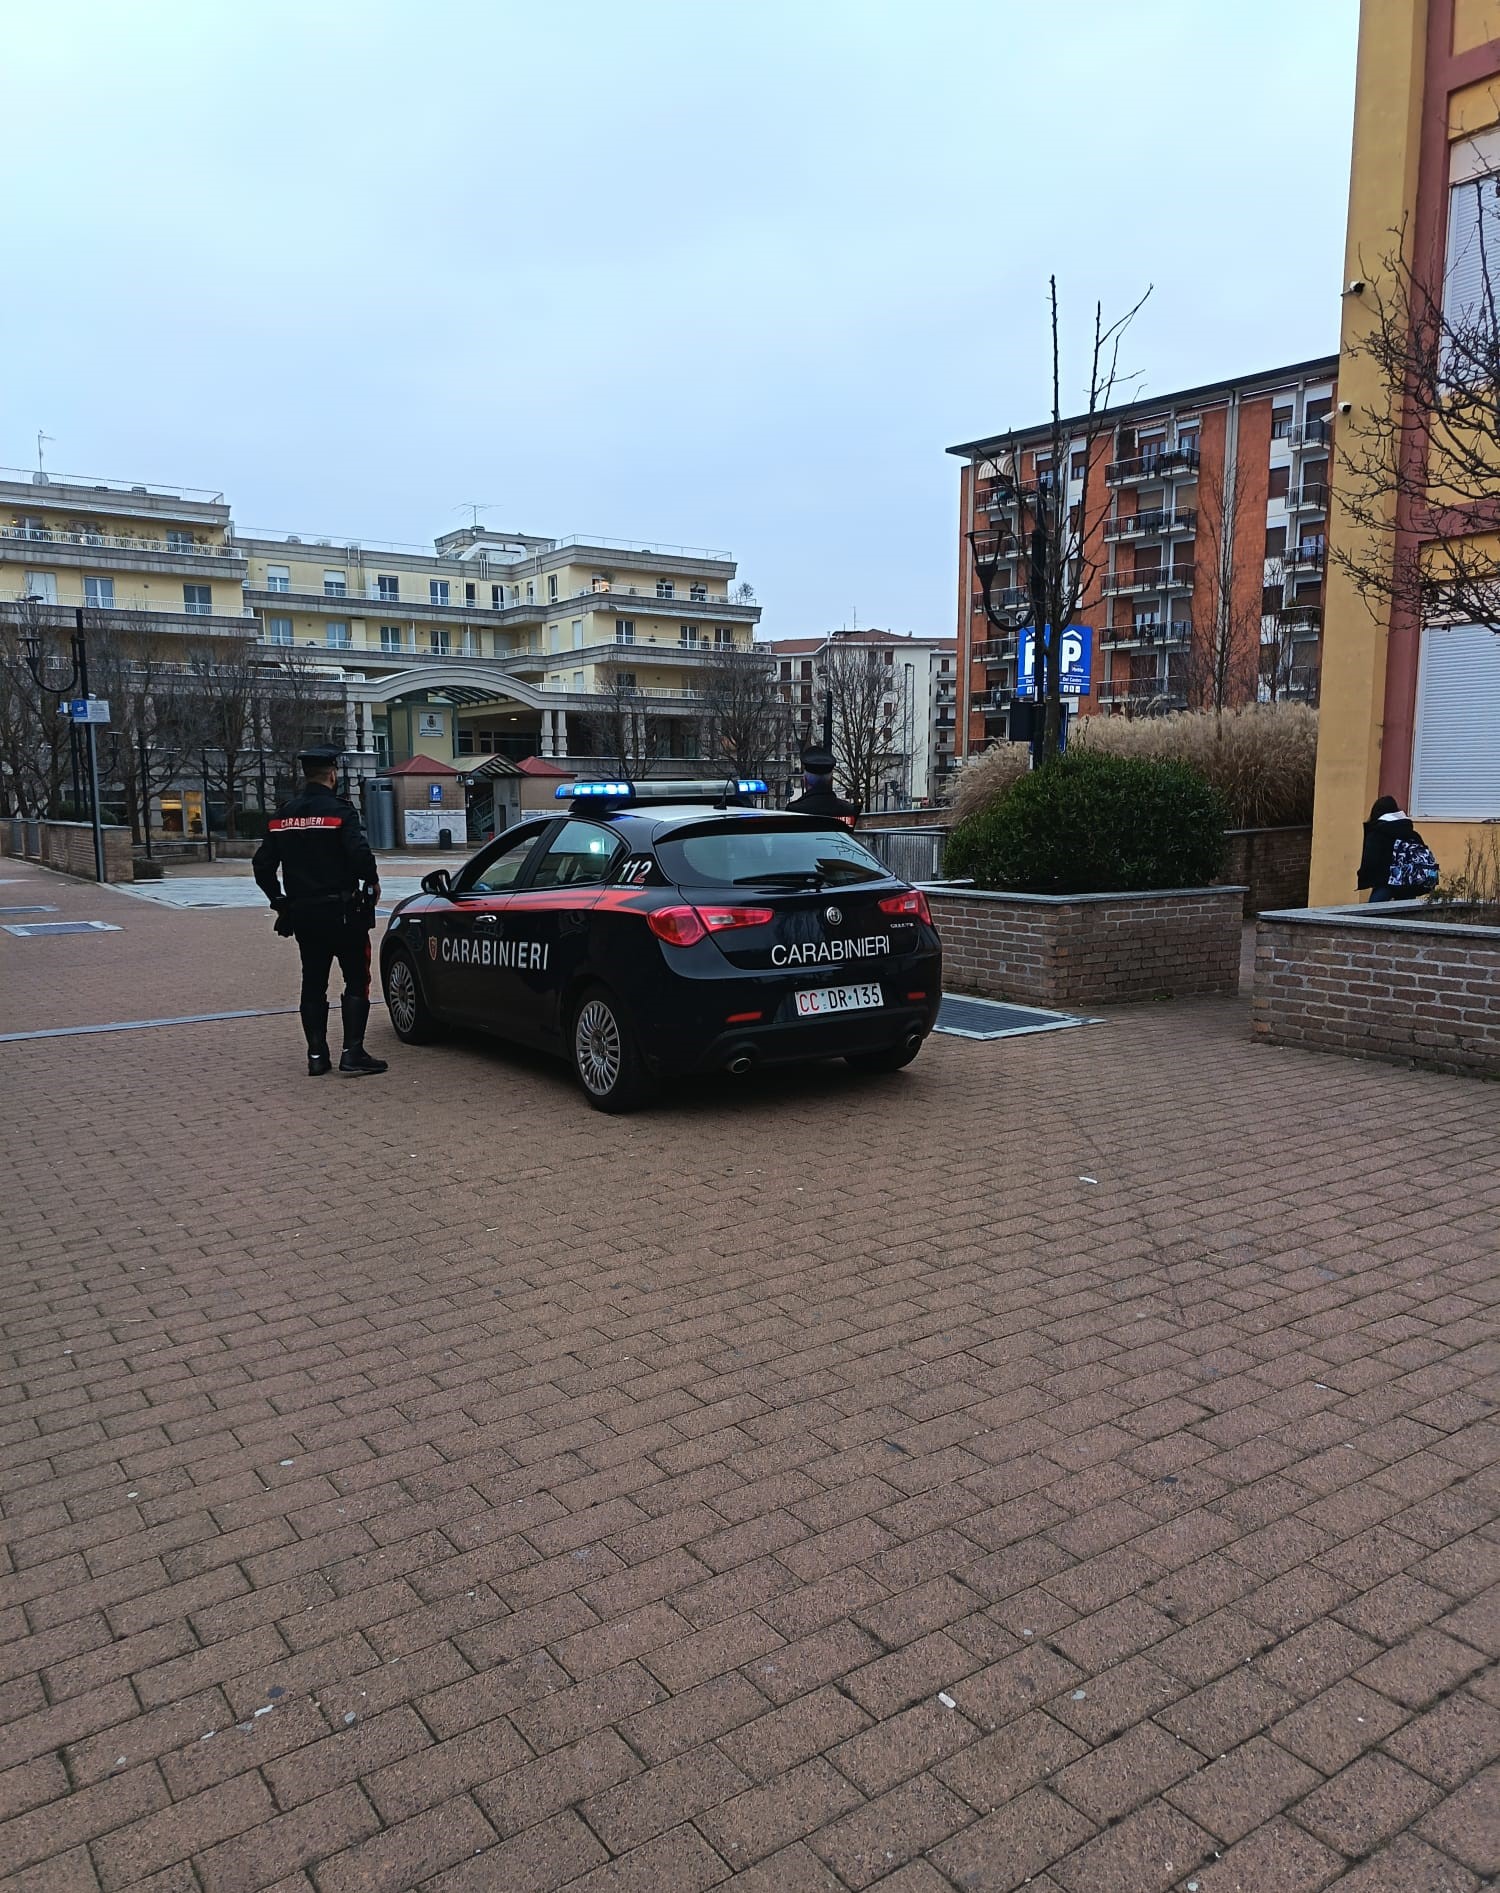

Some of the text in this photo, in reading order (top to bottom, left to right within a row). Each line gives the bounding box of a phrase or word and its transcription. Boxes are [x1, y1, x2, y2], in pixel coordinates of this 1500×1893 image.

[1062, 639, 1081, 673] P
[617, 860, 652, 884] 112
[441, 937, 549, 971] CARABINIERI
[771, 935, 890, 966] CARABINIERI
[799, 985, 880, 1013] CC DR 135
